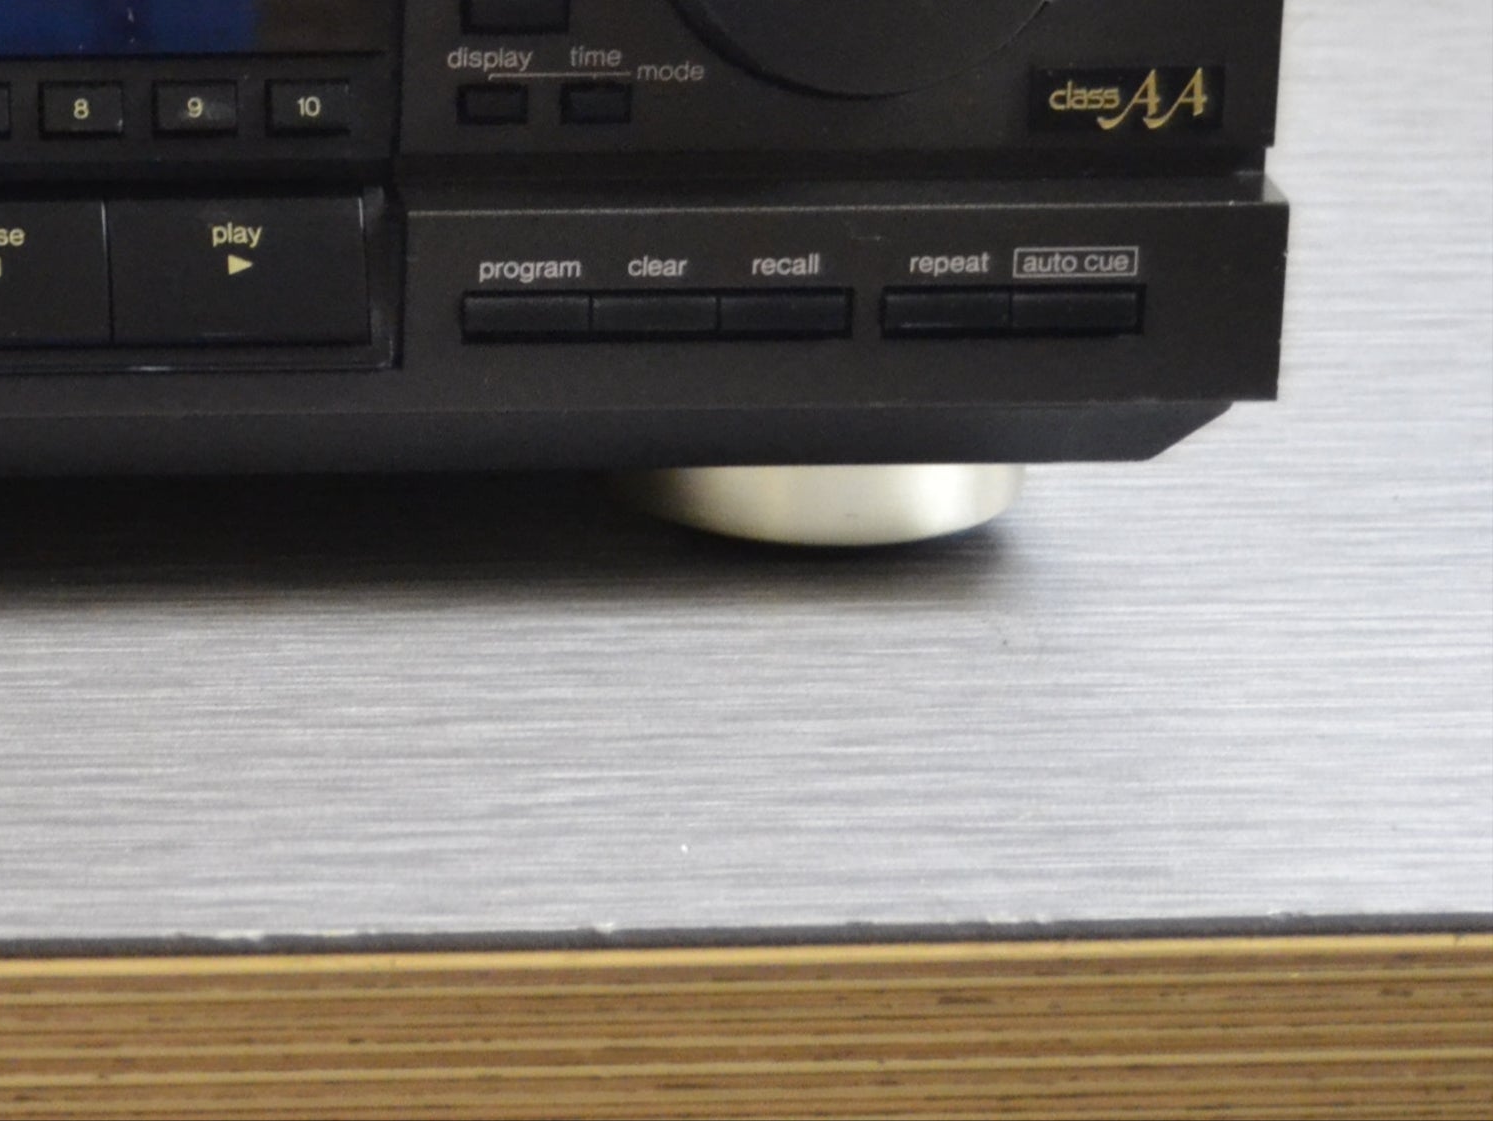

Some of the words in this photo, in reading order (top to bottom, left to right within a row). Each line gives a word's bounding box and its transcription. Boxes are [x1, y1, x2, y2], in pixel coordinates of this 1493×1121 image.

[447, 48, 533, 72] display
[569, 47, 622, 67] time
[637, 60, 705, 81] mode
[1049, 81, 1120, 110] class
[74, 99, 89, 120] 8
[187, 98, 203, 118] 9
[298, 97, 321, 117] 10
[212, 221, 262, 247] play
[478, 256, 582, 283] program
[627, 255, 688, 277] clear
[751, 253, 821, 276] recall
[909, 251, 989, 275] repeat
[1022, 252, 1077, 272] auto
[1085, 253, 1130, 272] cue
